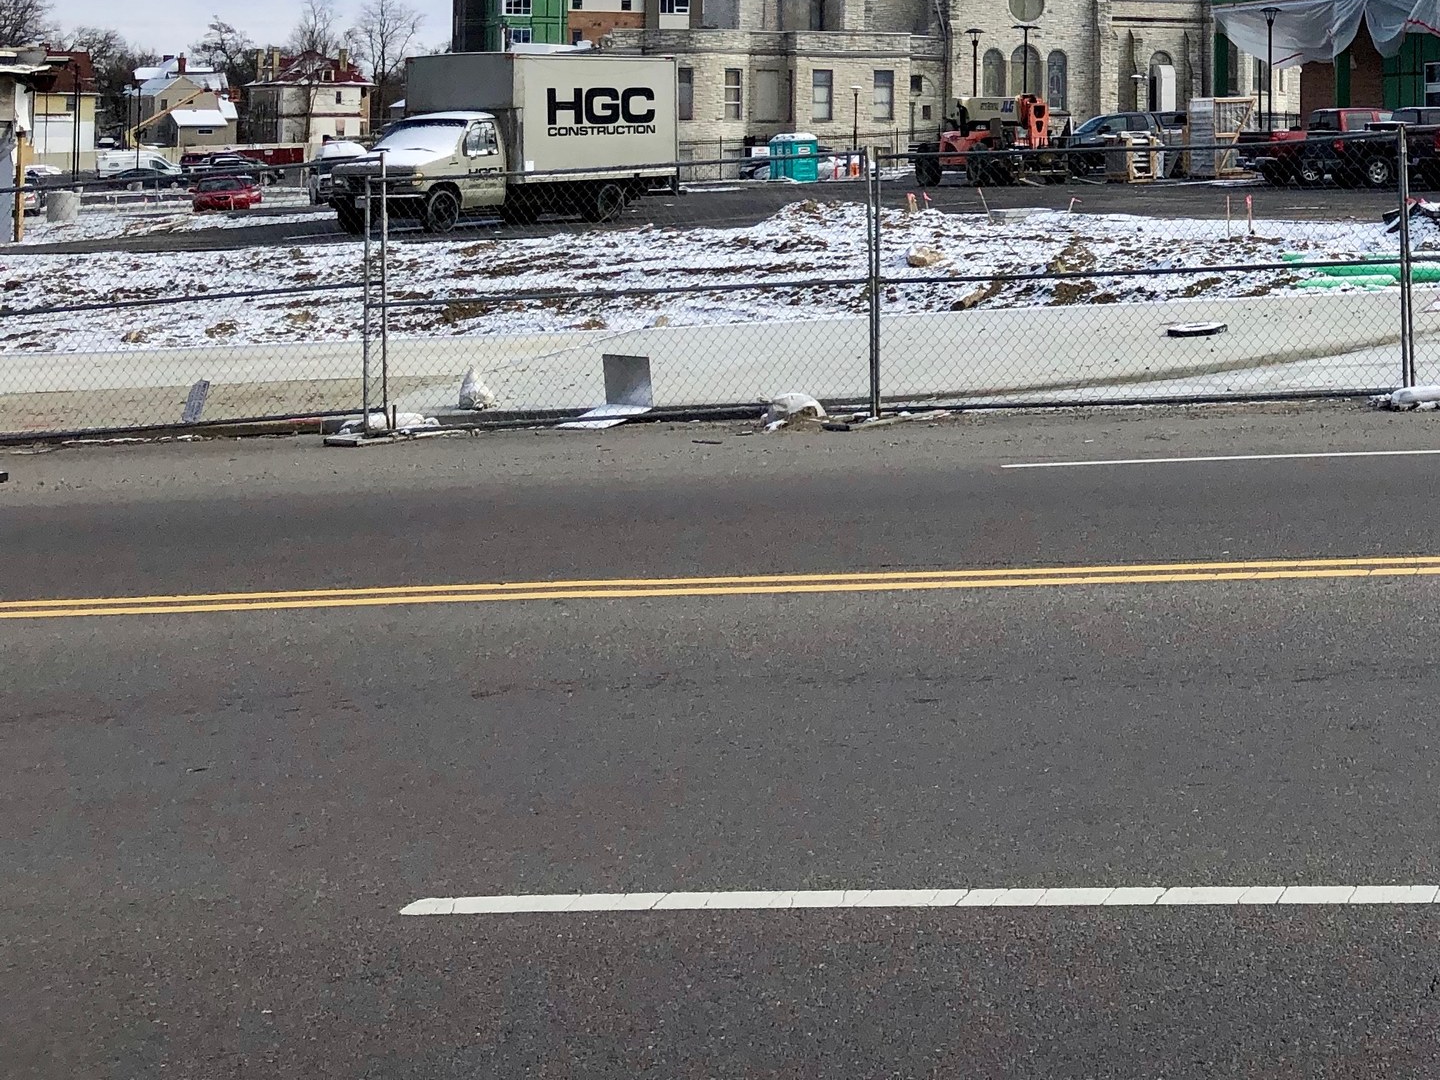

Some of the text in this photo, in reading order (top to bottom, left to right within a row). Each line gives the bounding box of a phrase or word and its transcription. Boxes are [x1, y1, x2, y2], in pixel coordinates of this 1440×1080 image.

[547, 87, 655, 125] HGC
[1000, 100, 1015, 113] JLG
[547, 125, 656, 137] CONSTRUCTION
